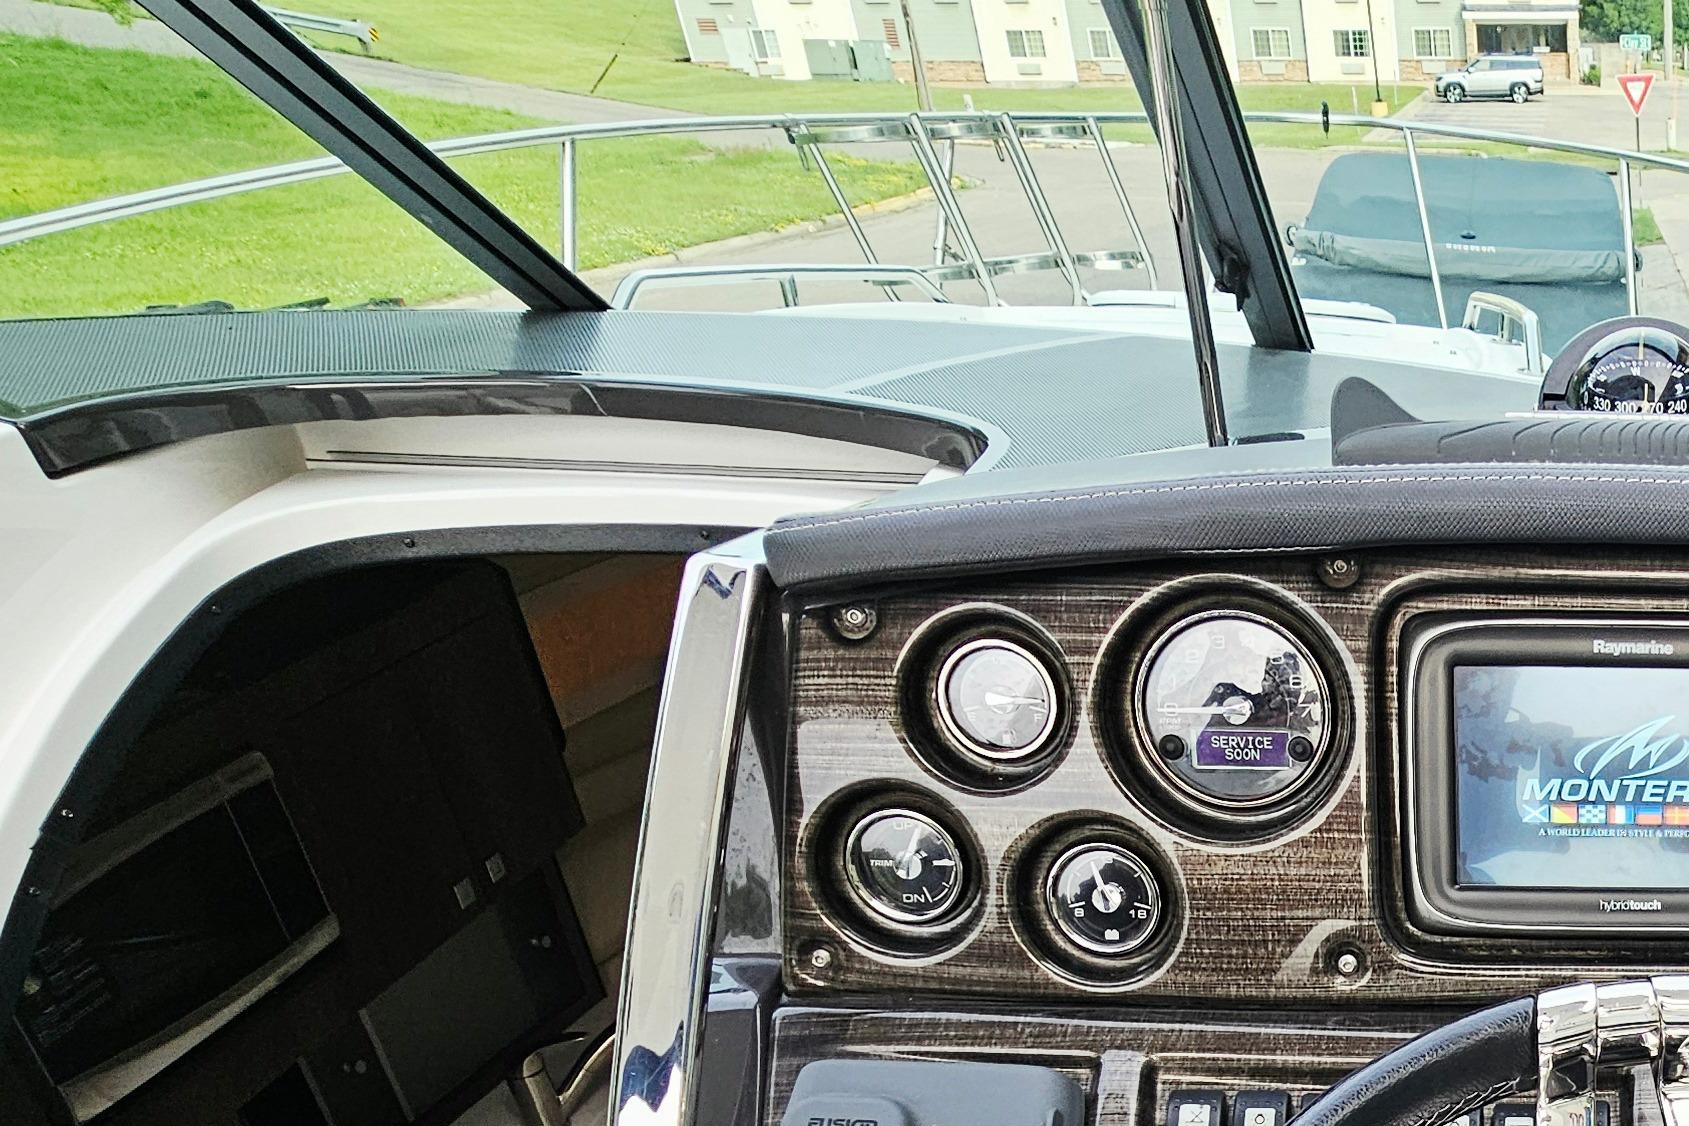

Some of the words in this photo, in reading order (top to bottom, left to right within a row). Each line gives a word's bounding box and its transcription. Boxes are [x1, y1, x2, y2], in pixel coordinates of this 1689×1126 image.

[1593, 396, 1611, 411] 330
[1615, 401, 1637, 413] 300
[1667, 399, 1687, 412] 240
[1593, 639, 1674, 657] Raymarine
[1211, 736, 1273, 749] SERVICE
[1225, 749, 1260, 761] SOON
[893, 821, 911, 830] UP
[1546, 828, 1581, 837] WORLD
[1582, 828, 1616, 837] LEADER
[870, 859, 894, 867] TRIM
[902, 893, 925, 903] DN
[1599, 899, 1662, 912] hybridtouch
